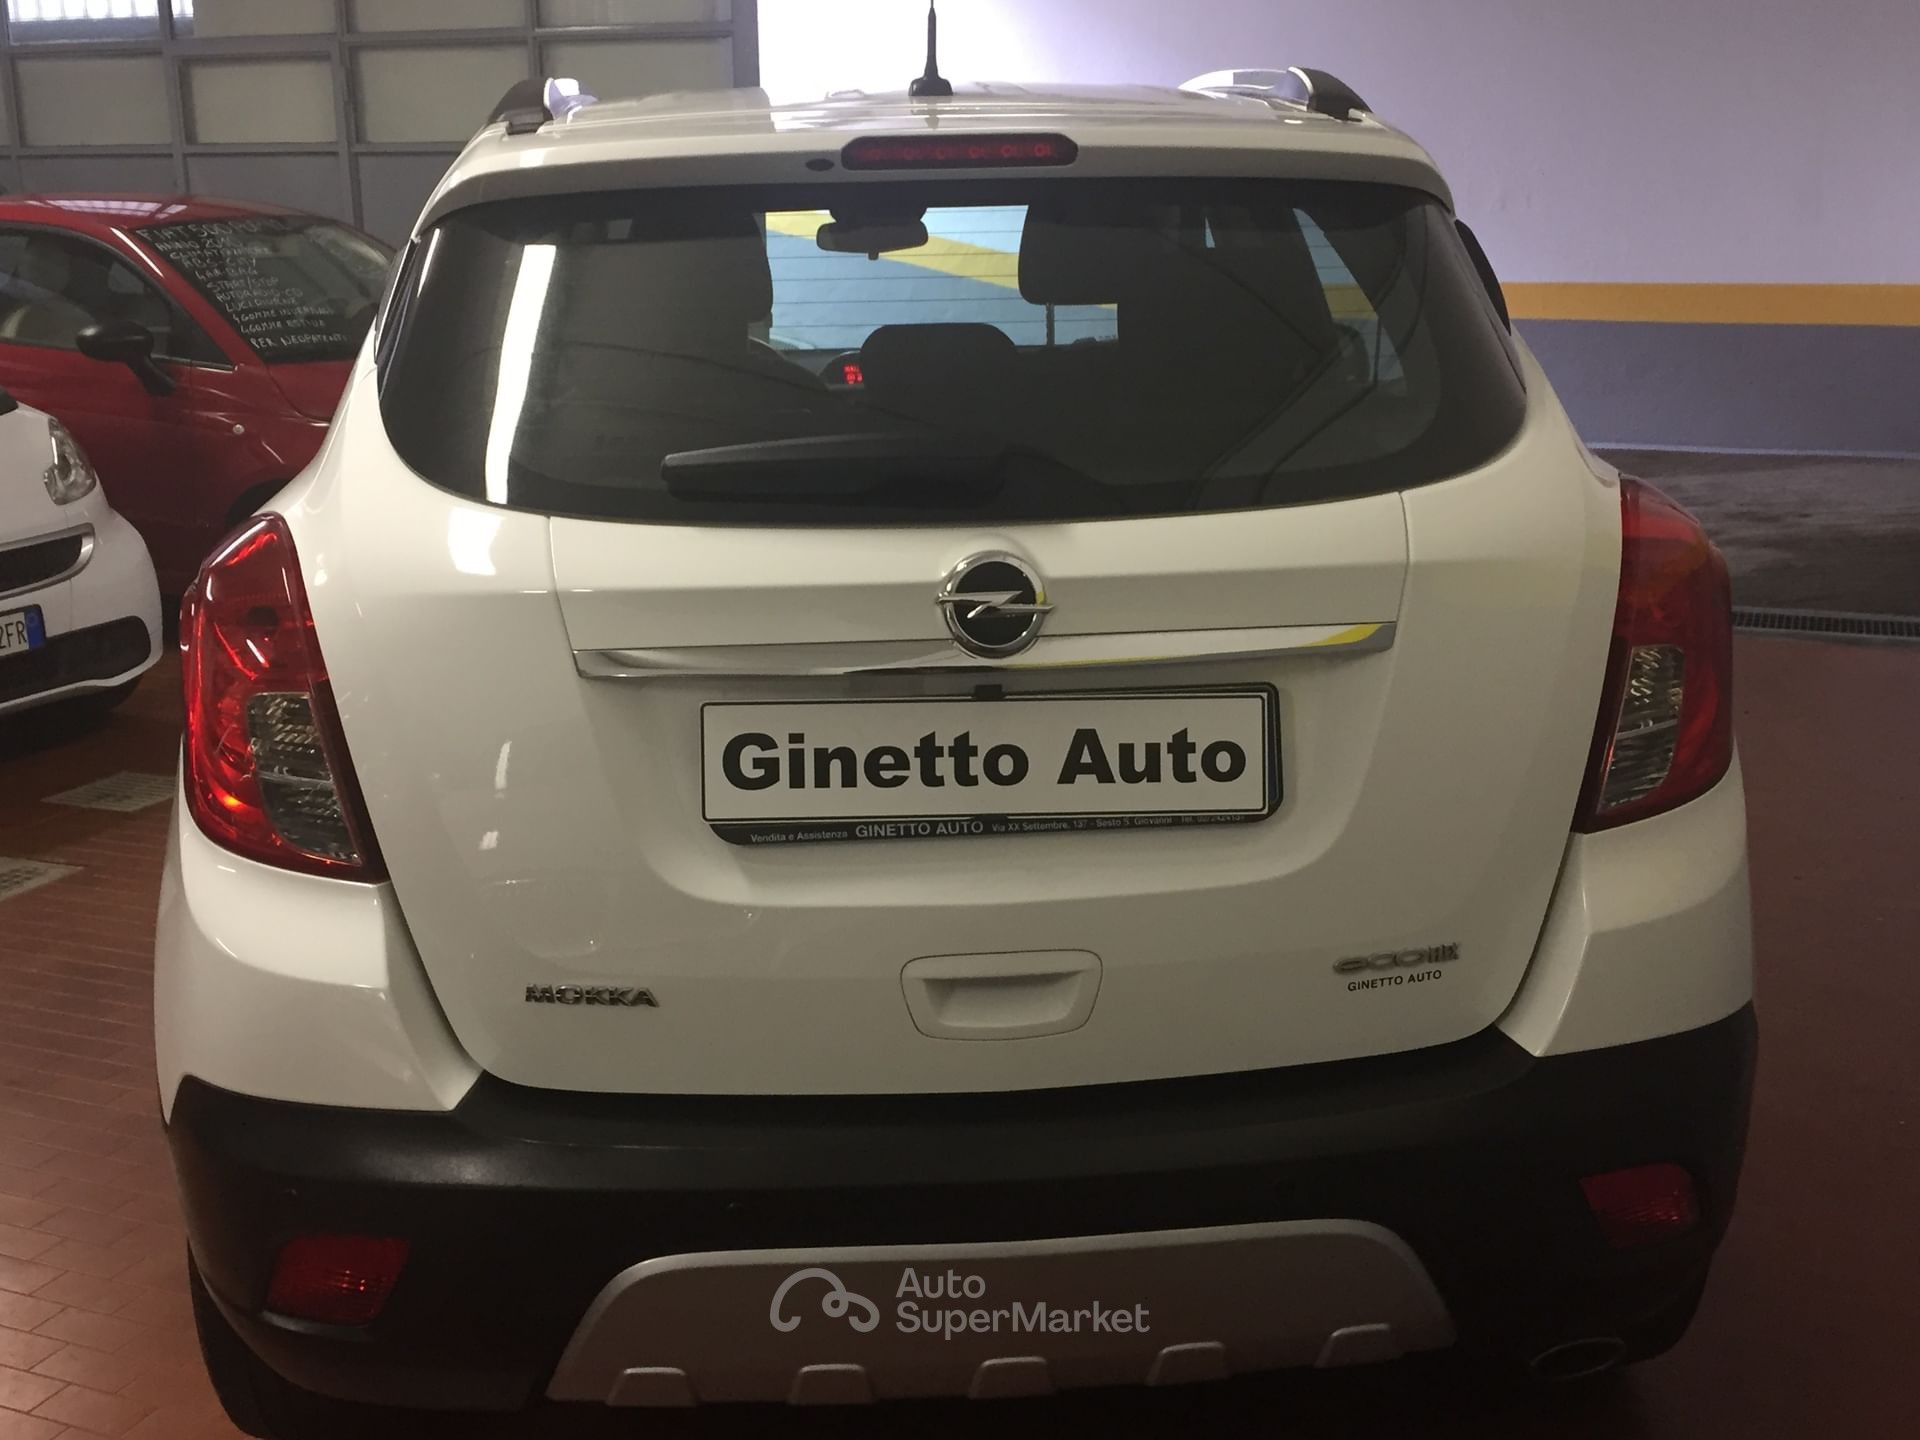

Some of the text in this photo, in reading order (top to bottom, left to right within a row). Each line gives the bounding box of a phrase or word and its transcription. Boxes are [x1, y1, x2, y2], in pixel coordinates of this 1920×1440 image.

[135, 224, 188, 241] FIAT
[240, 309, 277, 322] GOMME
[250, 336, 278, 349] PER
[722, 727, 1247, 791] Ginetto Auto
[855, 820, 984, 837] GINETTO AUTO
[991, 823, 1006, 832] Via
[1007, 821, 1021, 831] XX
[750, 833, 787, 843] Vendita
[796, 830, 848, 841] Assistenza
[1347, 970, 1442, 992] GINETTO AUTO
[525, 983, 661, 1008] MOKKA
